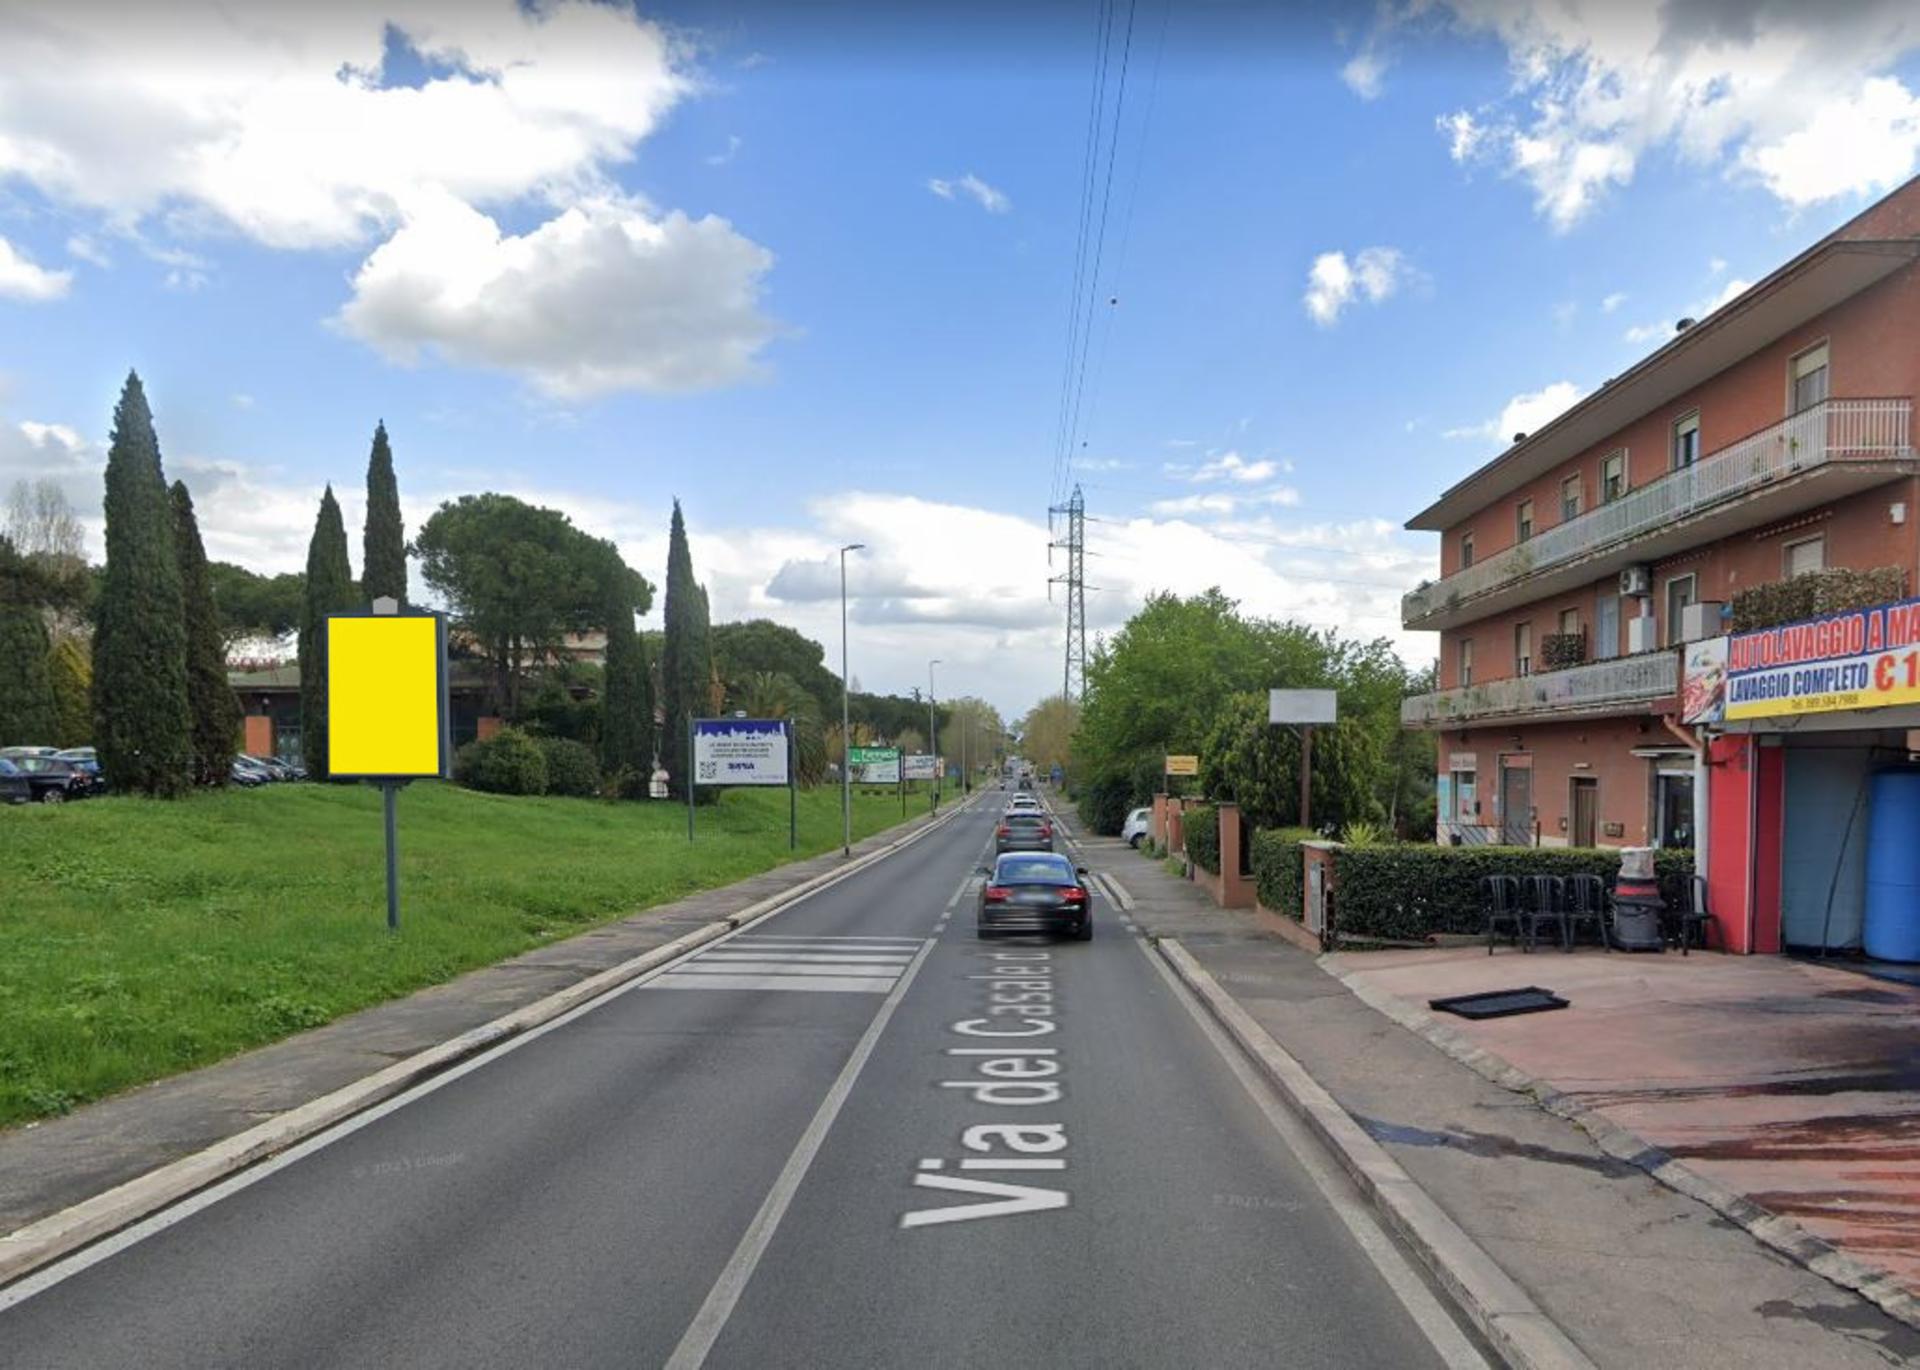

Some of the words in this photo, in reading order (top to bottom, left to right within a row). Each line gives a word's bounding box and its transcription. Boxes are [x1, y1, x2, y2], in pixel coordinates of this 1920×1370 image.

[1730, 615, 1864, 671] AUTOLAVAGGIO
[1867, 610, 1883, 651] A
[1730, 674, 1790, 703] LAVAGGIO
[1793, 663, 1868, 695] COMPLETO
[1874, 654, 1896, 691] €
[1903, 651, 1920, 688] 1
